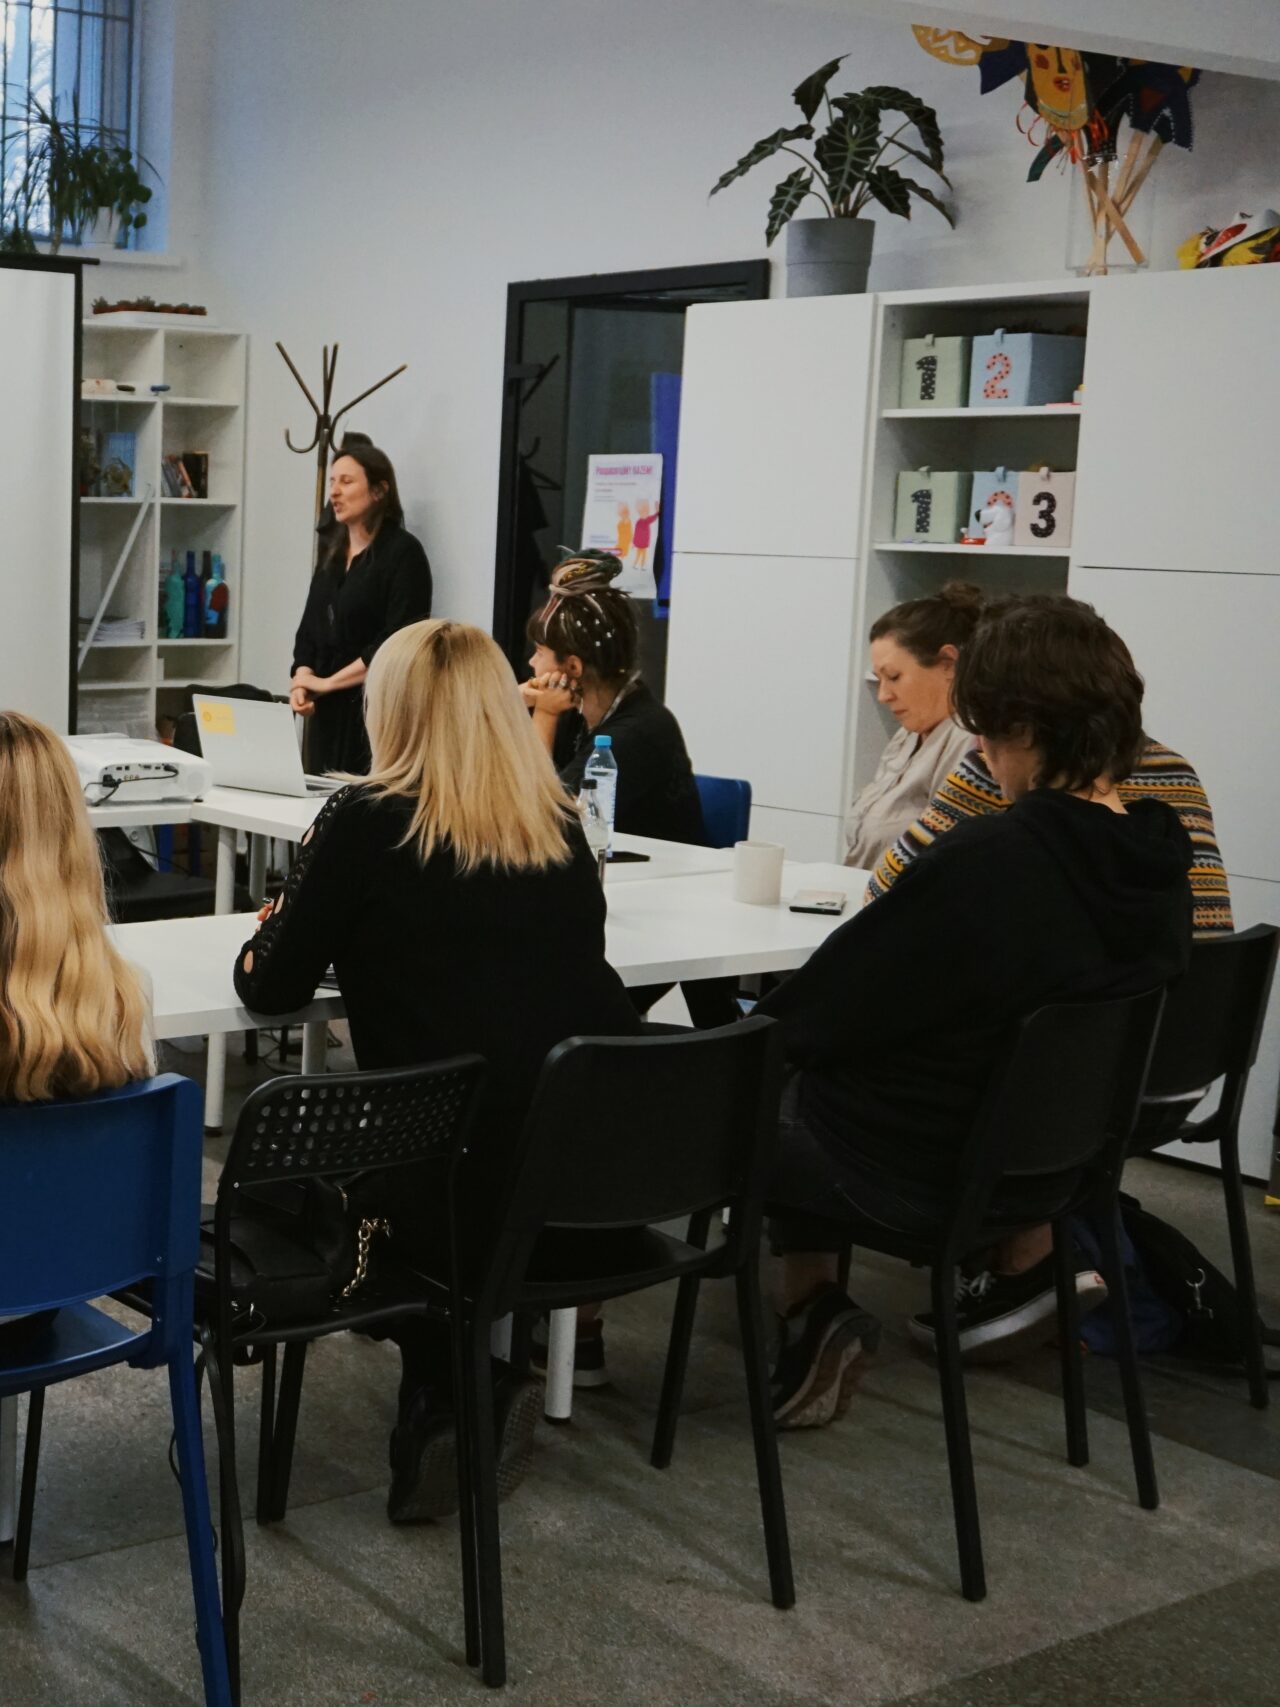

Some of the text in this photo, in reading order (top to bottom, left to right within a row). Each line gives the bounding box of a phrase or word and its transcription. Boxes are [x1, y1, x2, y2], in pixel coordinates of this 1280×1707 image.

[915, 354, 938, 400] 1
[982, 352, 1013, 399] 2
[910, 488, 932, 533] 1
[1030, 491, 1057, 538] 3
